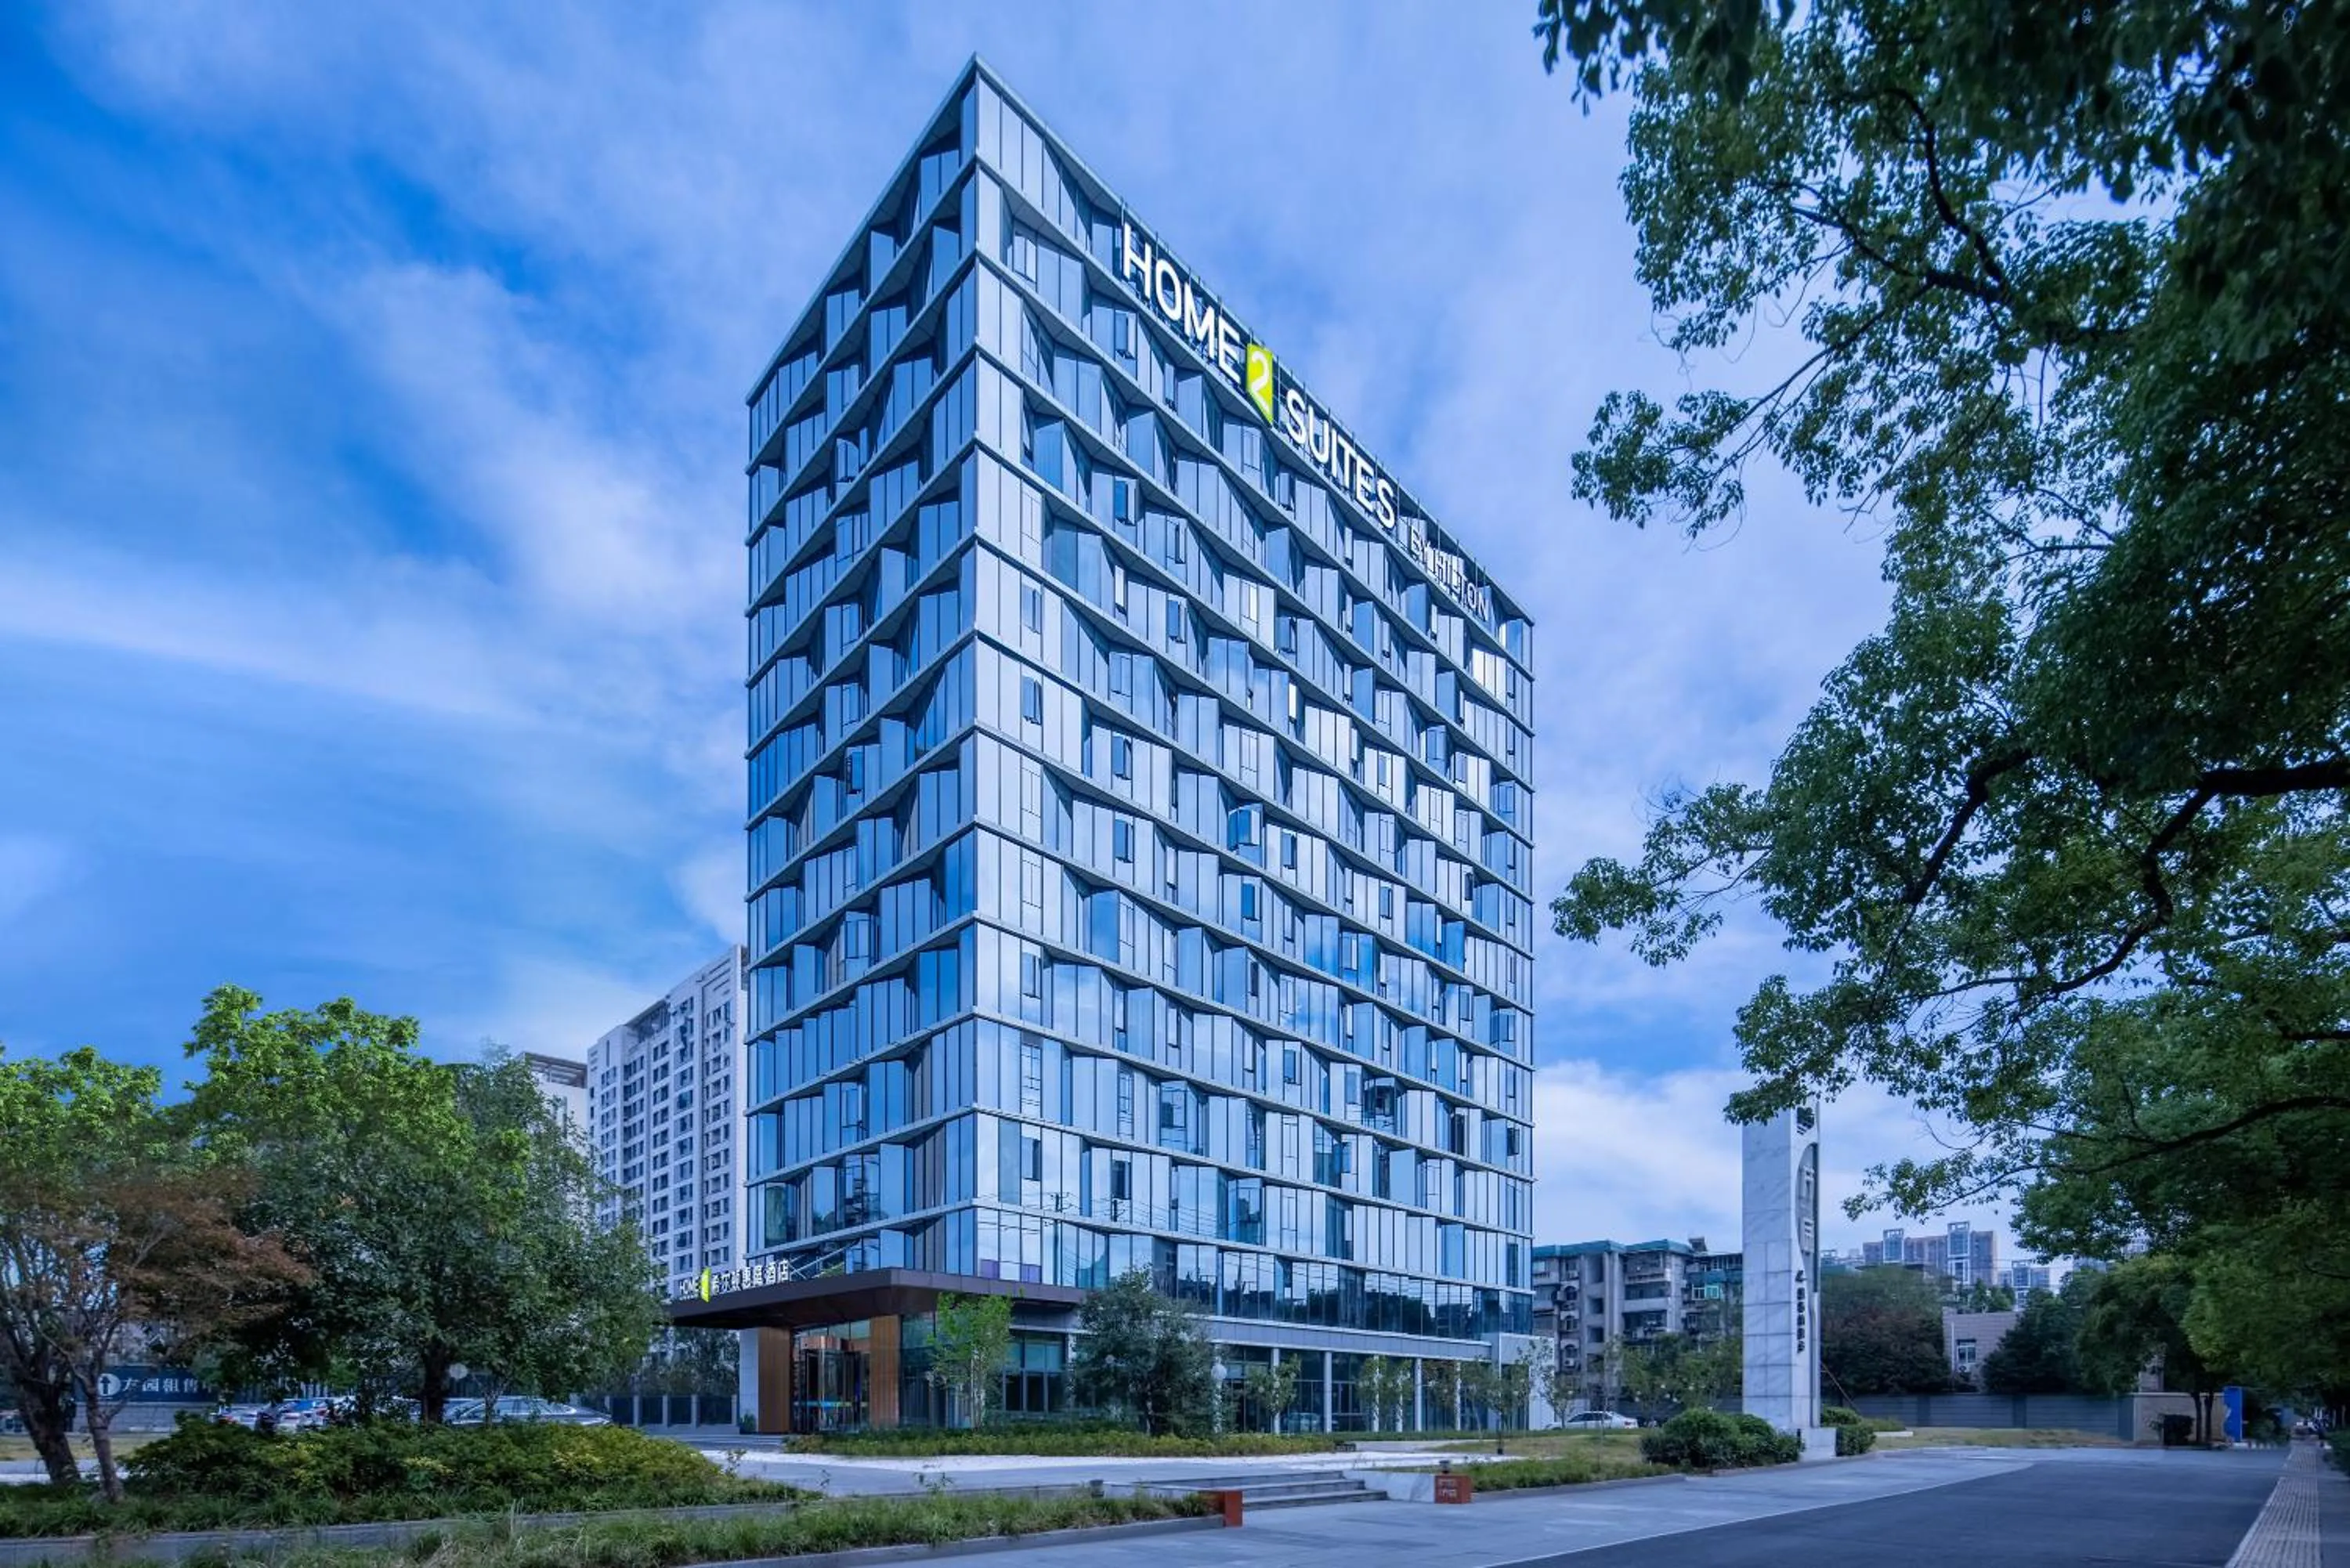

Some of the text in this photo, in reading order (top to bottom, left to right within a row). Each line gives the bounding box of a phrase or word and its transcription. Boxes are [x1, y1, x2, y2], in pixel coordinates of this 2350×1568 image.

[1123, 222, 1488, 622] HOME 2 SUITES BY HILTON
